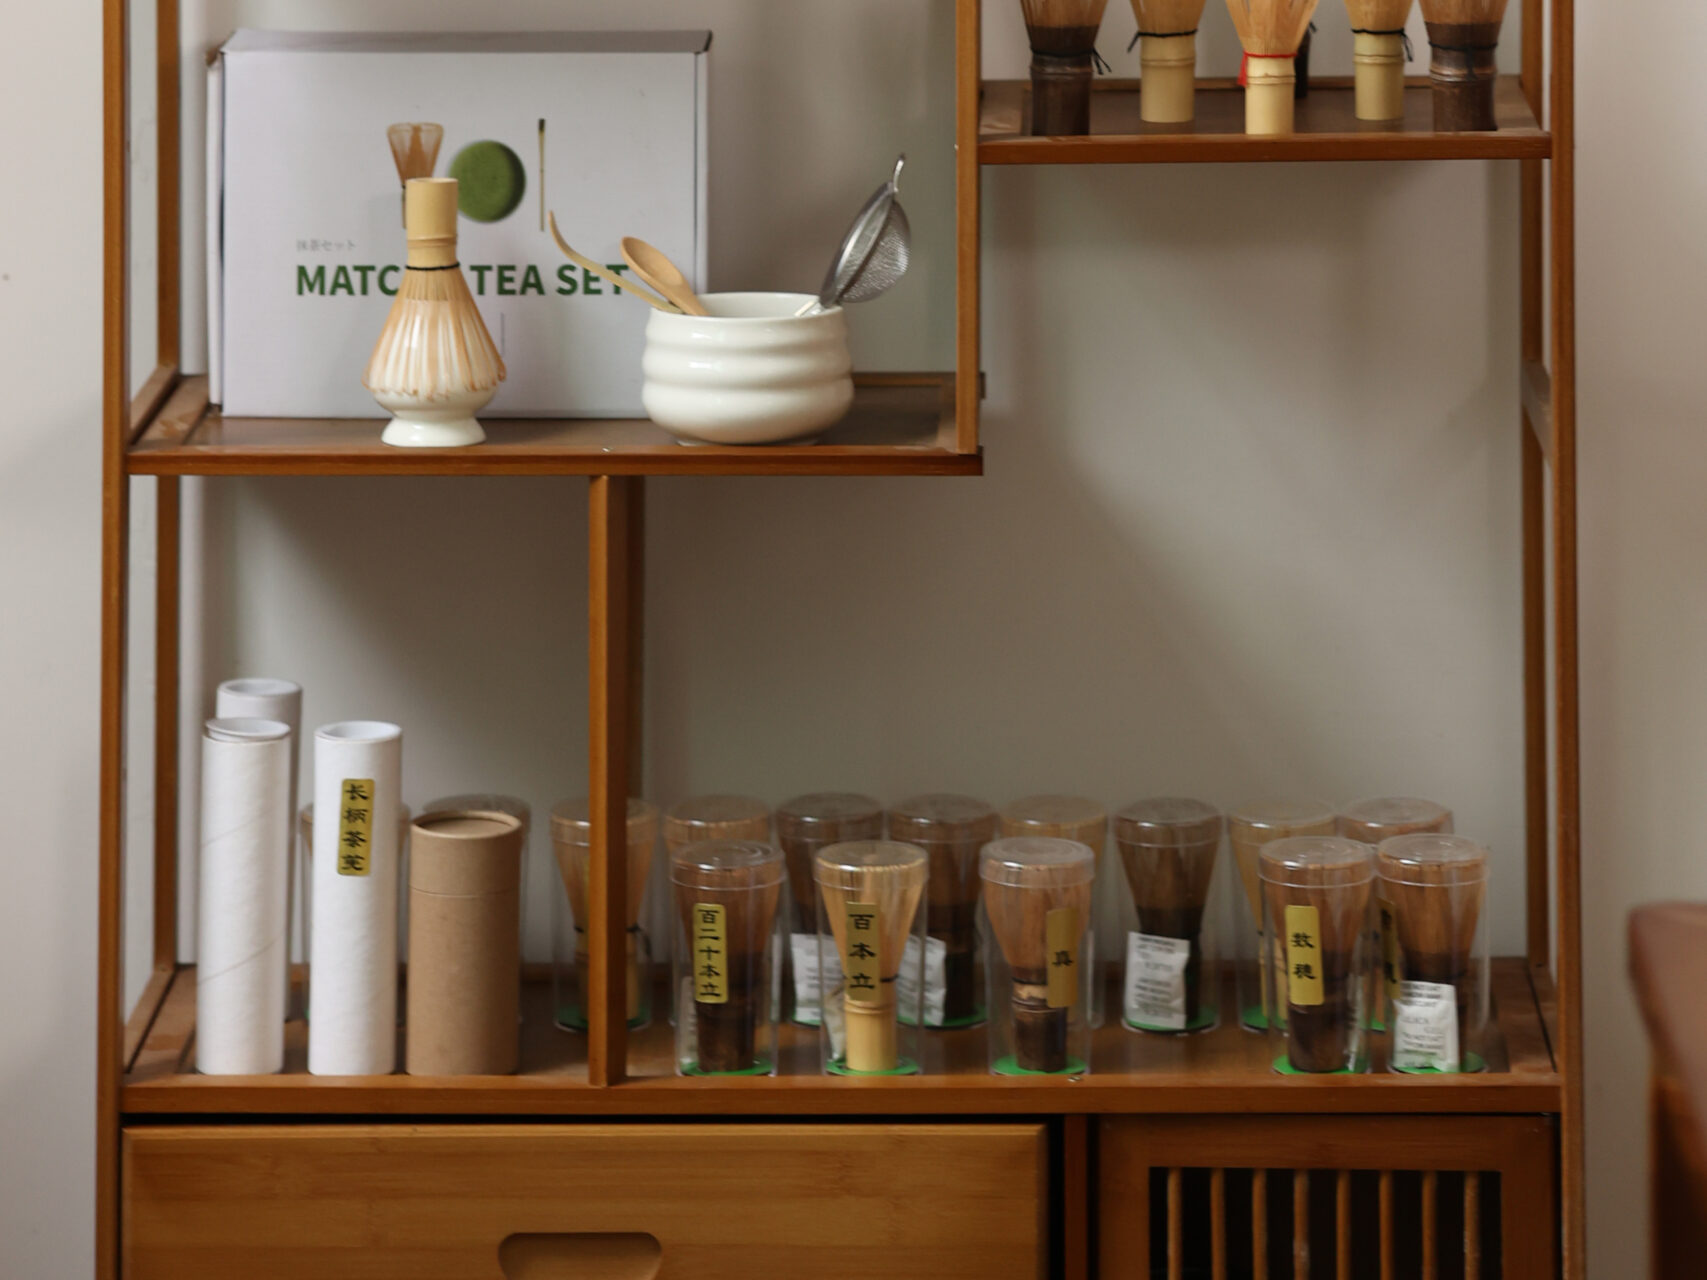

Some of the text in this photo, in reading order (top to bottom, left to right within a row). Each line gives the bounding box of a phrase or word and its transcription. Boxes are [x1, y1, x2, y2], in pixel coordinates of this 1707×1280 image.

[296, 264, 630, 296] MATC TEA SET
[697, 908, 722, 998] 百二十本立
[847, 912, 877, 990] 百本立
